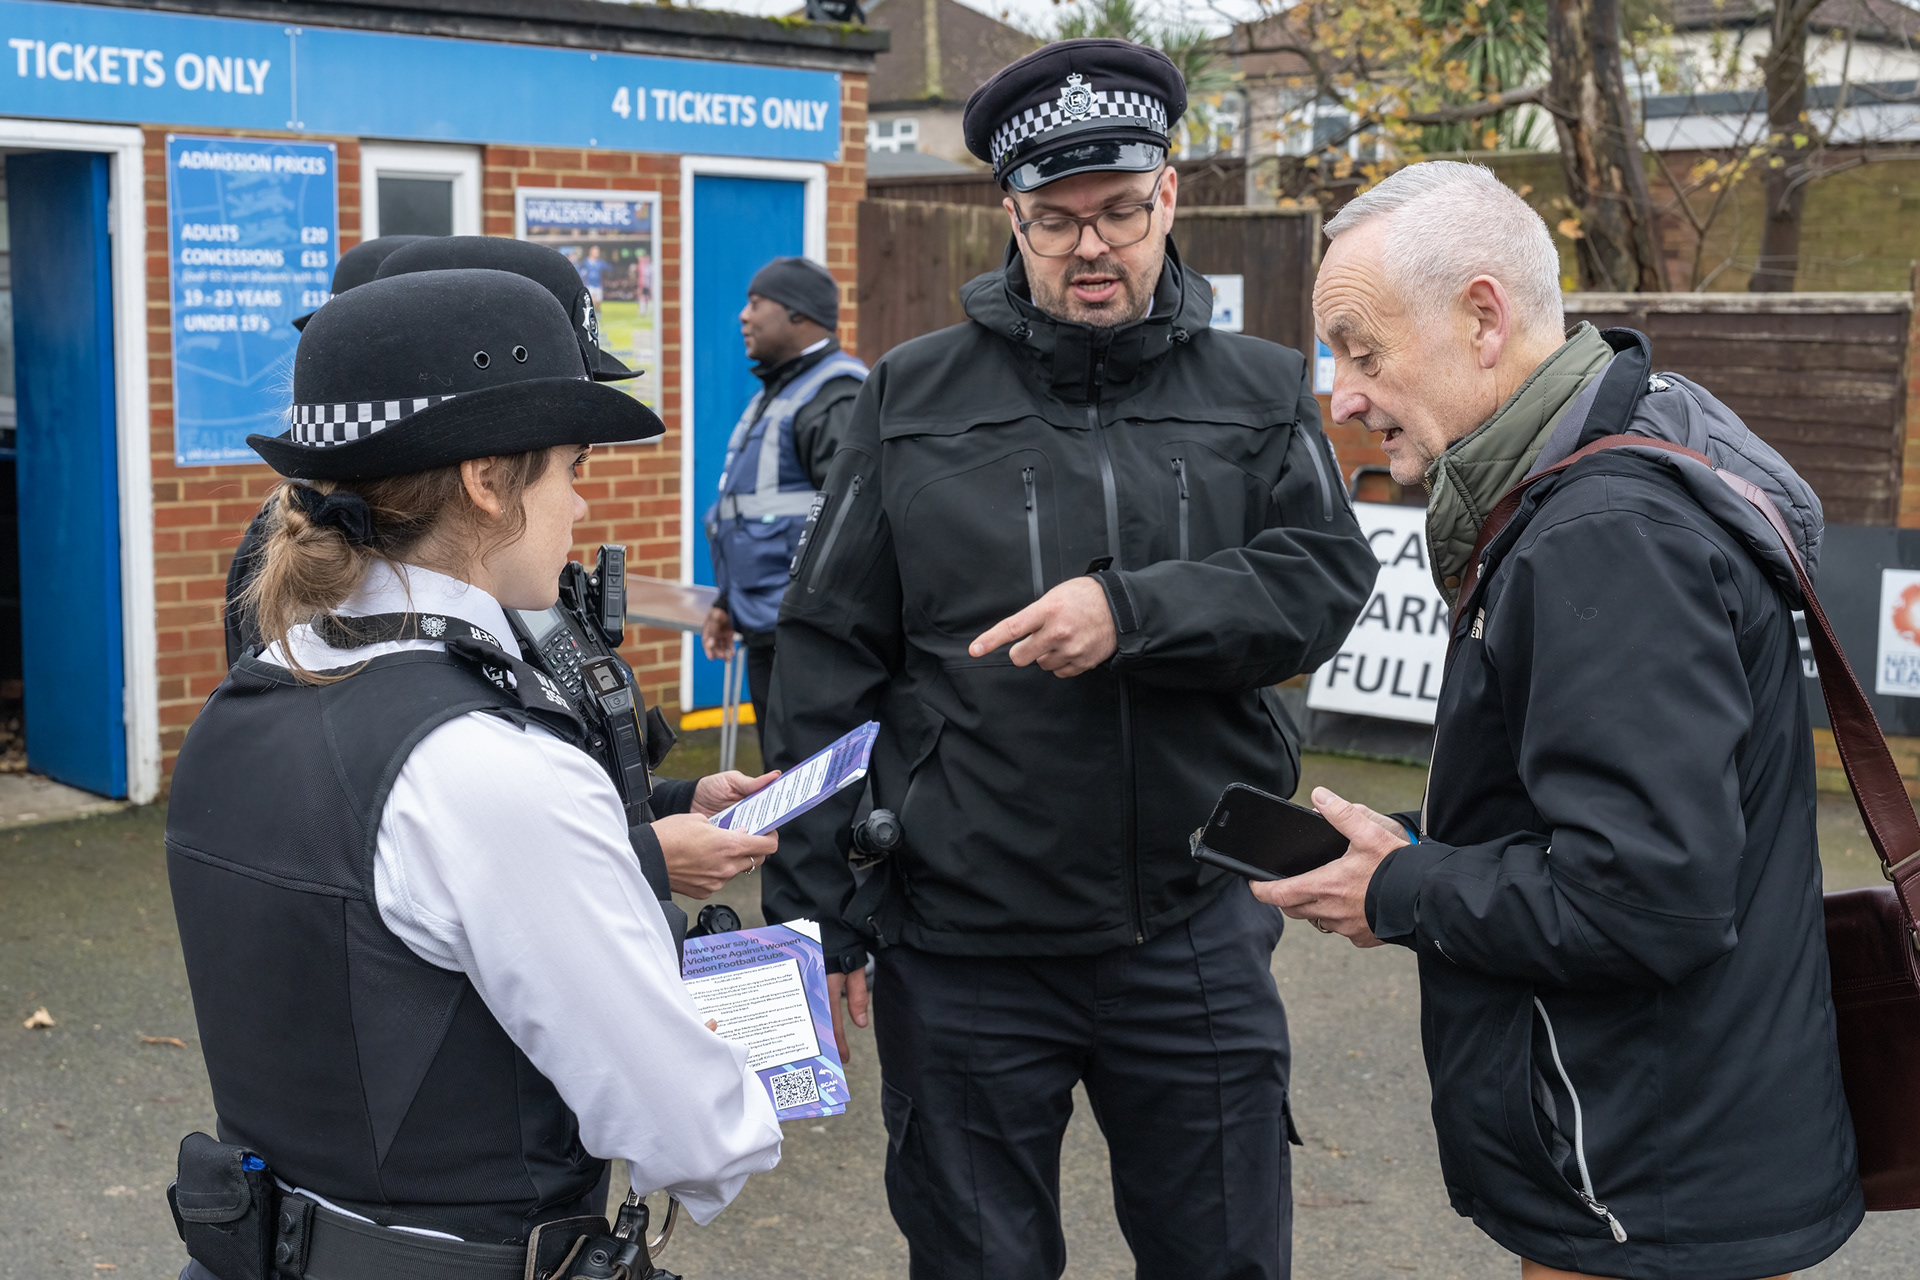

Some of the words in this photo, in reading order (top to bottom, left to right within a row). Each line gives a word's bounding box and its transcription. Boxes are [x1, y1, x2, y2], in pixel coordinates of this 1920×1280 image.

[8, 38, 166, 88] TICKETS
[174, 53, 271, 95] ONLY
[611, 86, 631, 119] 4
[651, 88, 757, 128] TICKETS
[762, 97, 829, 132] ONLY
[179, 151, 272, 173] ADMISSION
[274, 155, 327, 175] PRICES
[527, 205, 612, 225] WEALDSTONE
[614, 208, 631, 225] FC
[181, 224, 239, 242] ADULTS
[301, 227, 328, 244] £20
[181, 248, 284, 267] CONCESSIONS
[301, 251, 328, 268] £15
[184, 289, 203, 307] 19
[213, 289, 234, 307] 23
[235, 289, 282, 307] YEARS
[184, 314, 238, 332] UNDER
[1369, 529, 1427, 569] CA
[1357, 592, 1449, 636] ARK
[1327, 652, 1438, 701] FULL
[685, 946, 709, 956] Have
[710, 942, 732, 953] your
[732, 939, 749, 948] say
[750, 937, 759, 945] in
[686, 952, 728, 966] Violence
[728, 945, 765, 961] Against
[765, 938, 801, 951] Women
[717, 954, 756, 970] Football
[757, 951, 785, 963] Clubs
[820, 1079, 838, 1088] SCAN
